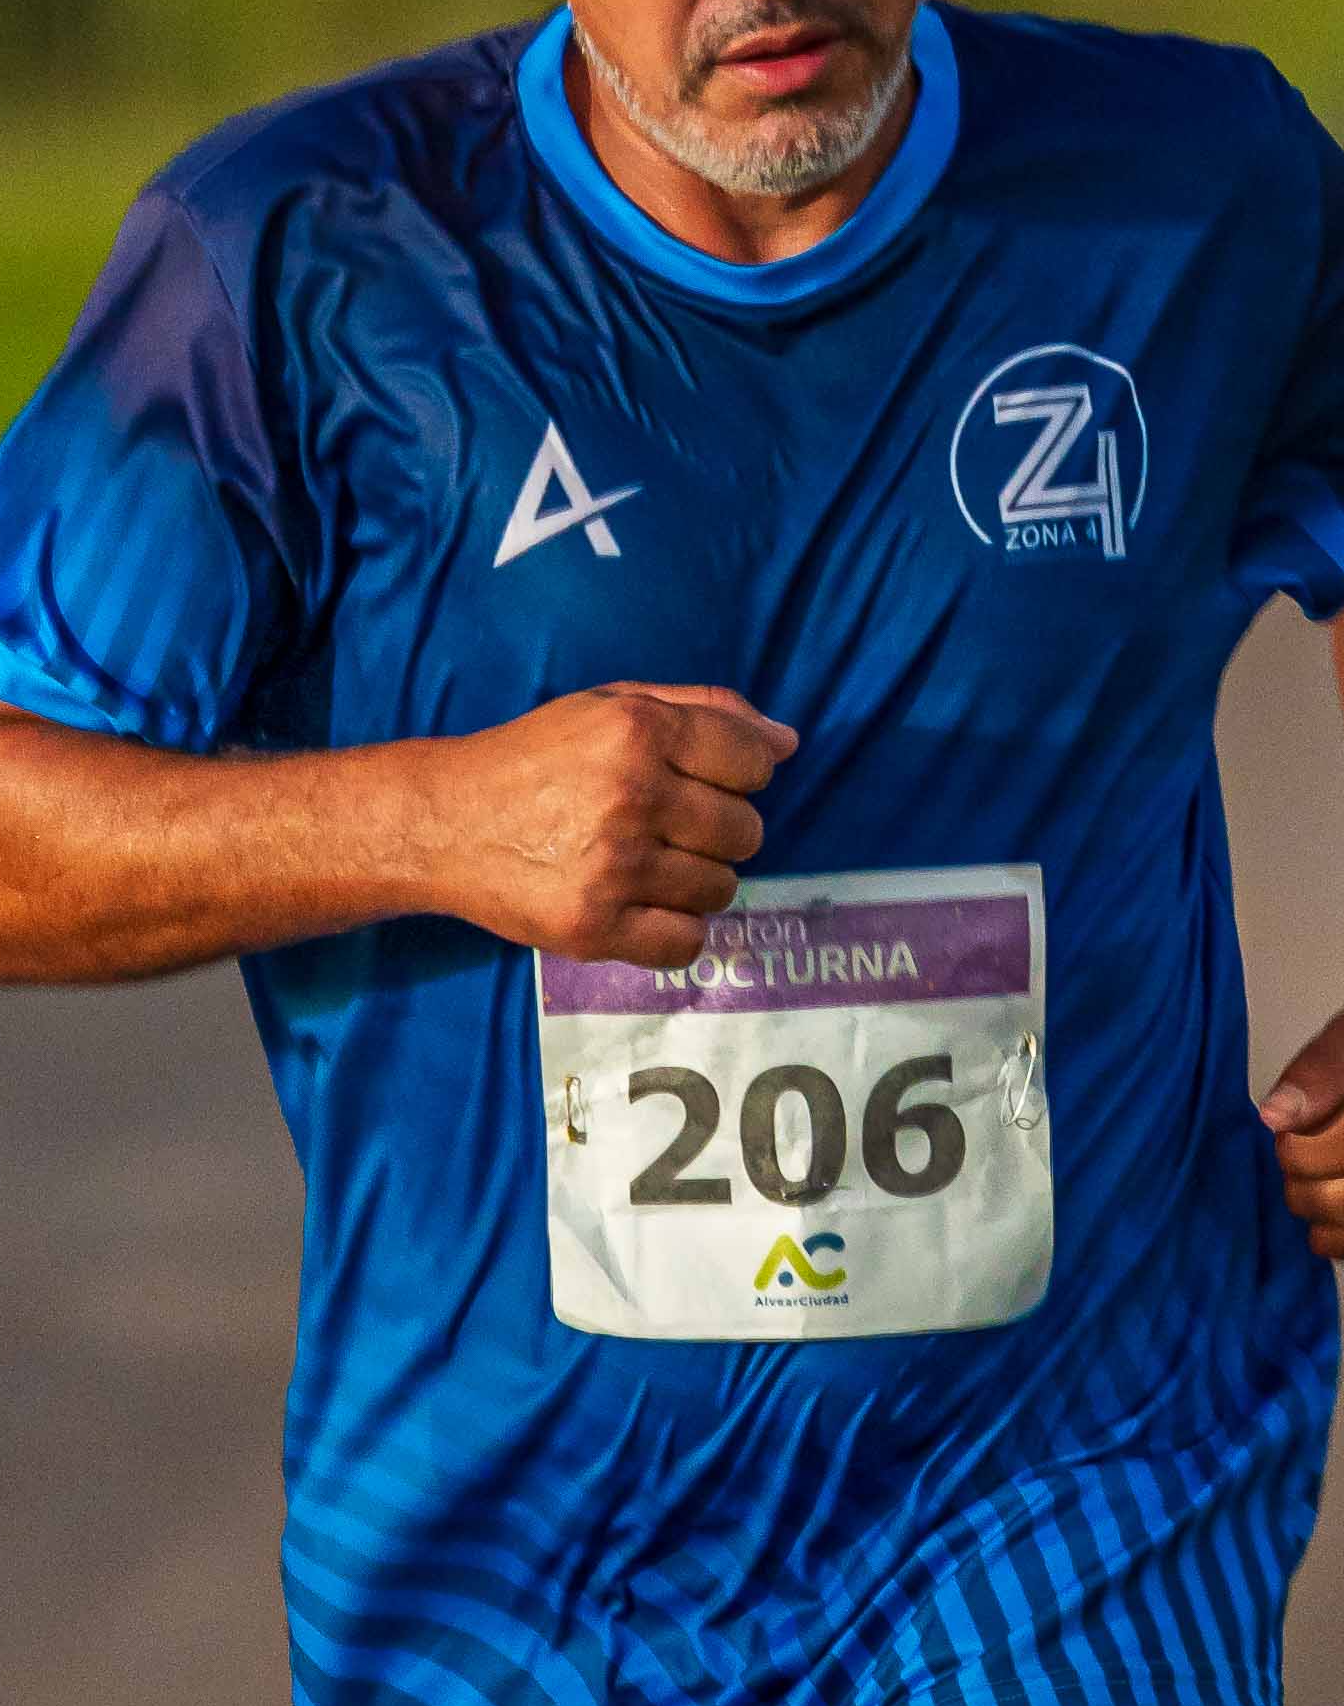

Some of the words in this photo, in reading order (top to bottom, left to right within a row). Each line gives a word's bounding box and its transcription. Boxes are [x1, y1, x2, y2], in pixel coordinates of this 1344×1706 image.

[1005, 520, 1076, 550] ZONA
[654, 940, 919, 991] NOCTURNA
[628, 1055, 966, 1208] 206
